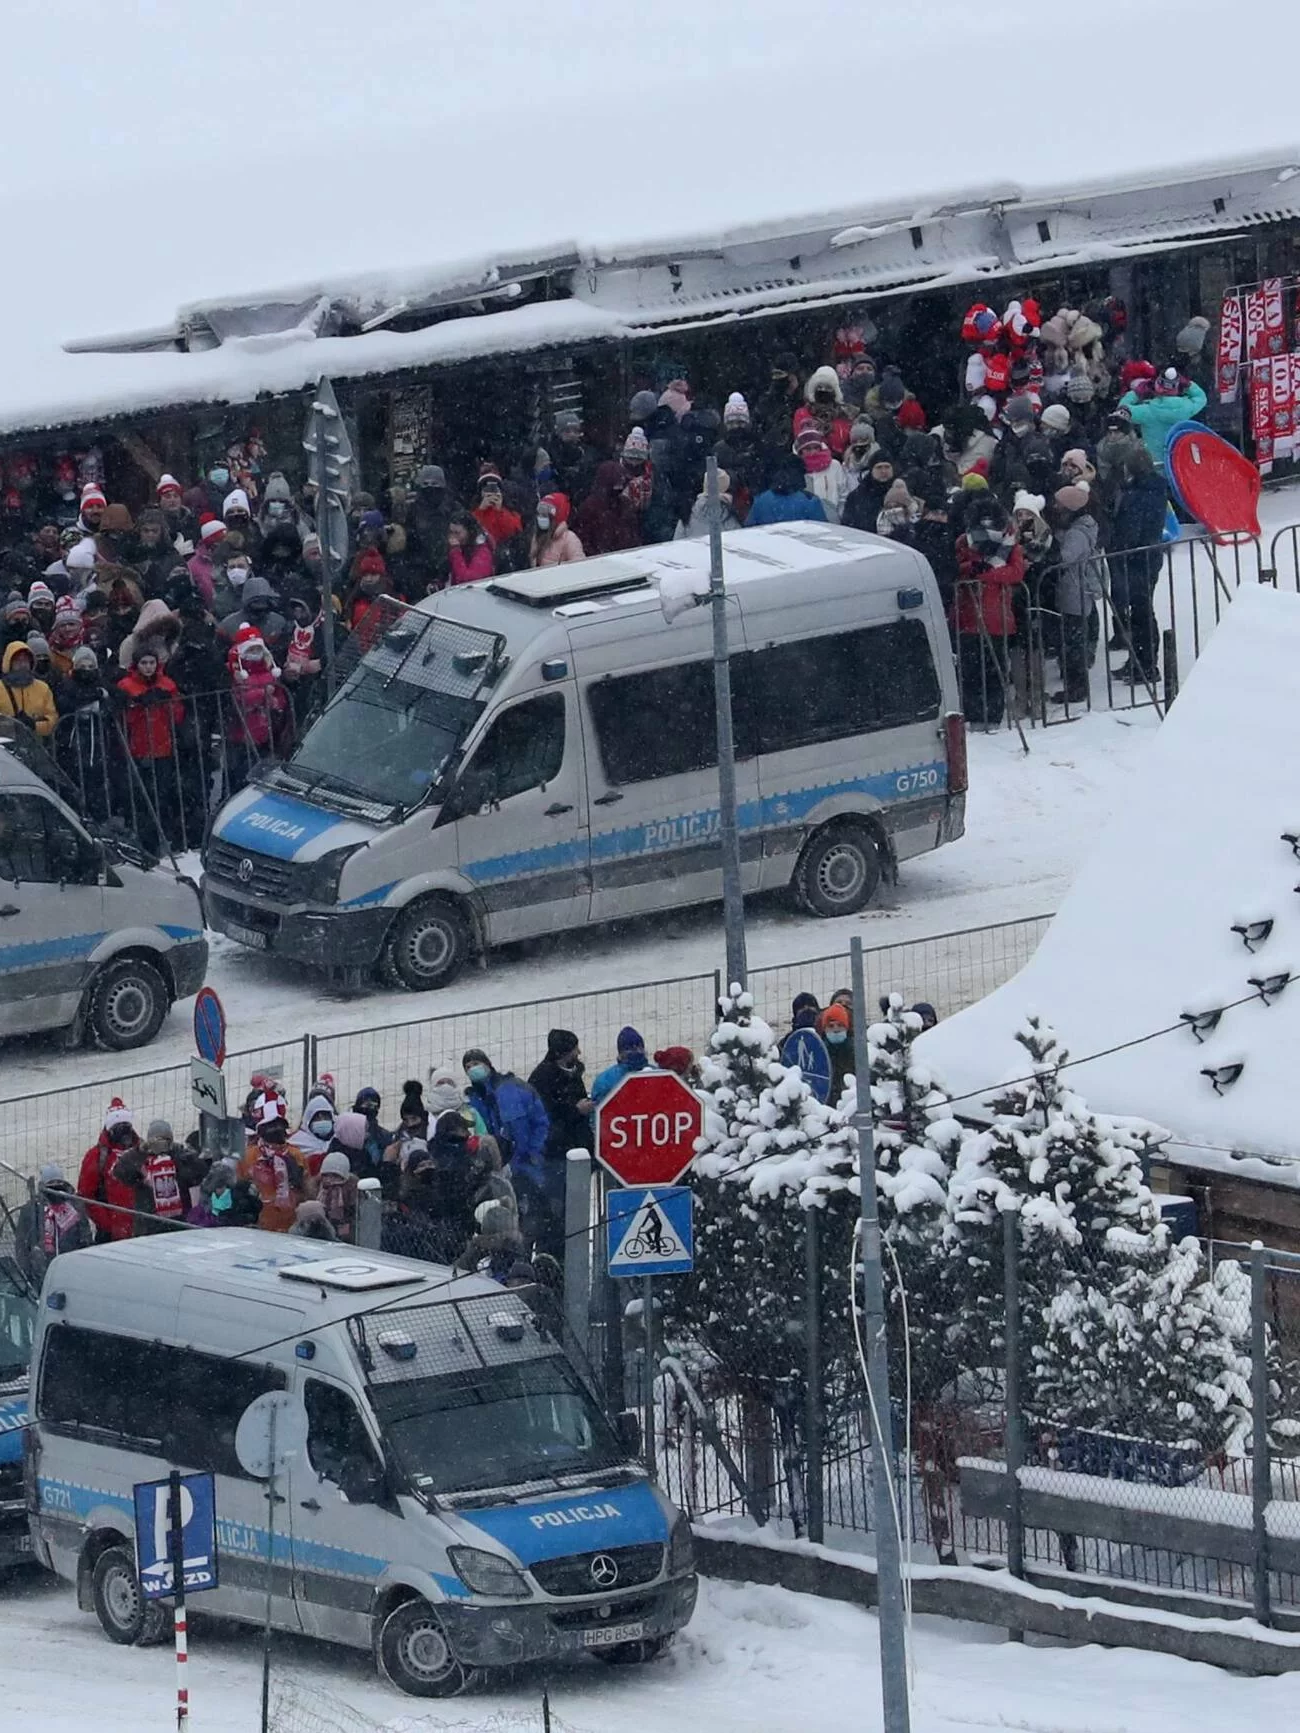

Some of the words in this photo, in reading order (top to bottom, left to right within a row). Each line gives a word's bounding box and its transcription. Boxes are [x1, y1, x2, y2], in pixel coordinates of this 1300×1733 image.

[896, 769, 937, 792] G750
[241, 812, 306, 840] POLICJA
[609, 1111, 693, 1149] STOP
[43, 1485, 72, 1509] G721
[154, 1484, 194, 1561] P
[529, 1503, 622, 1530] POLICJA
[142, 1571, 211, 1592] WJZD
[586, 1629, 612, 1645] HPG
